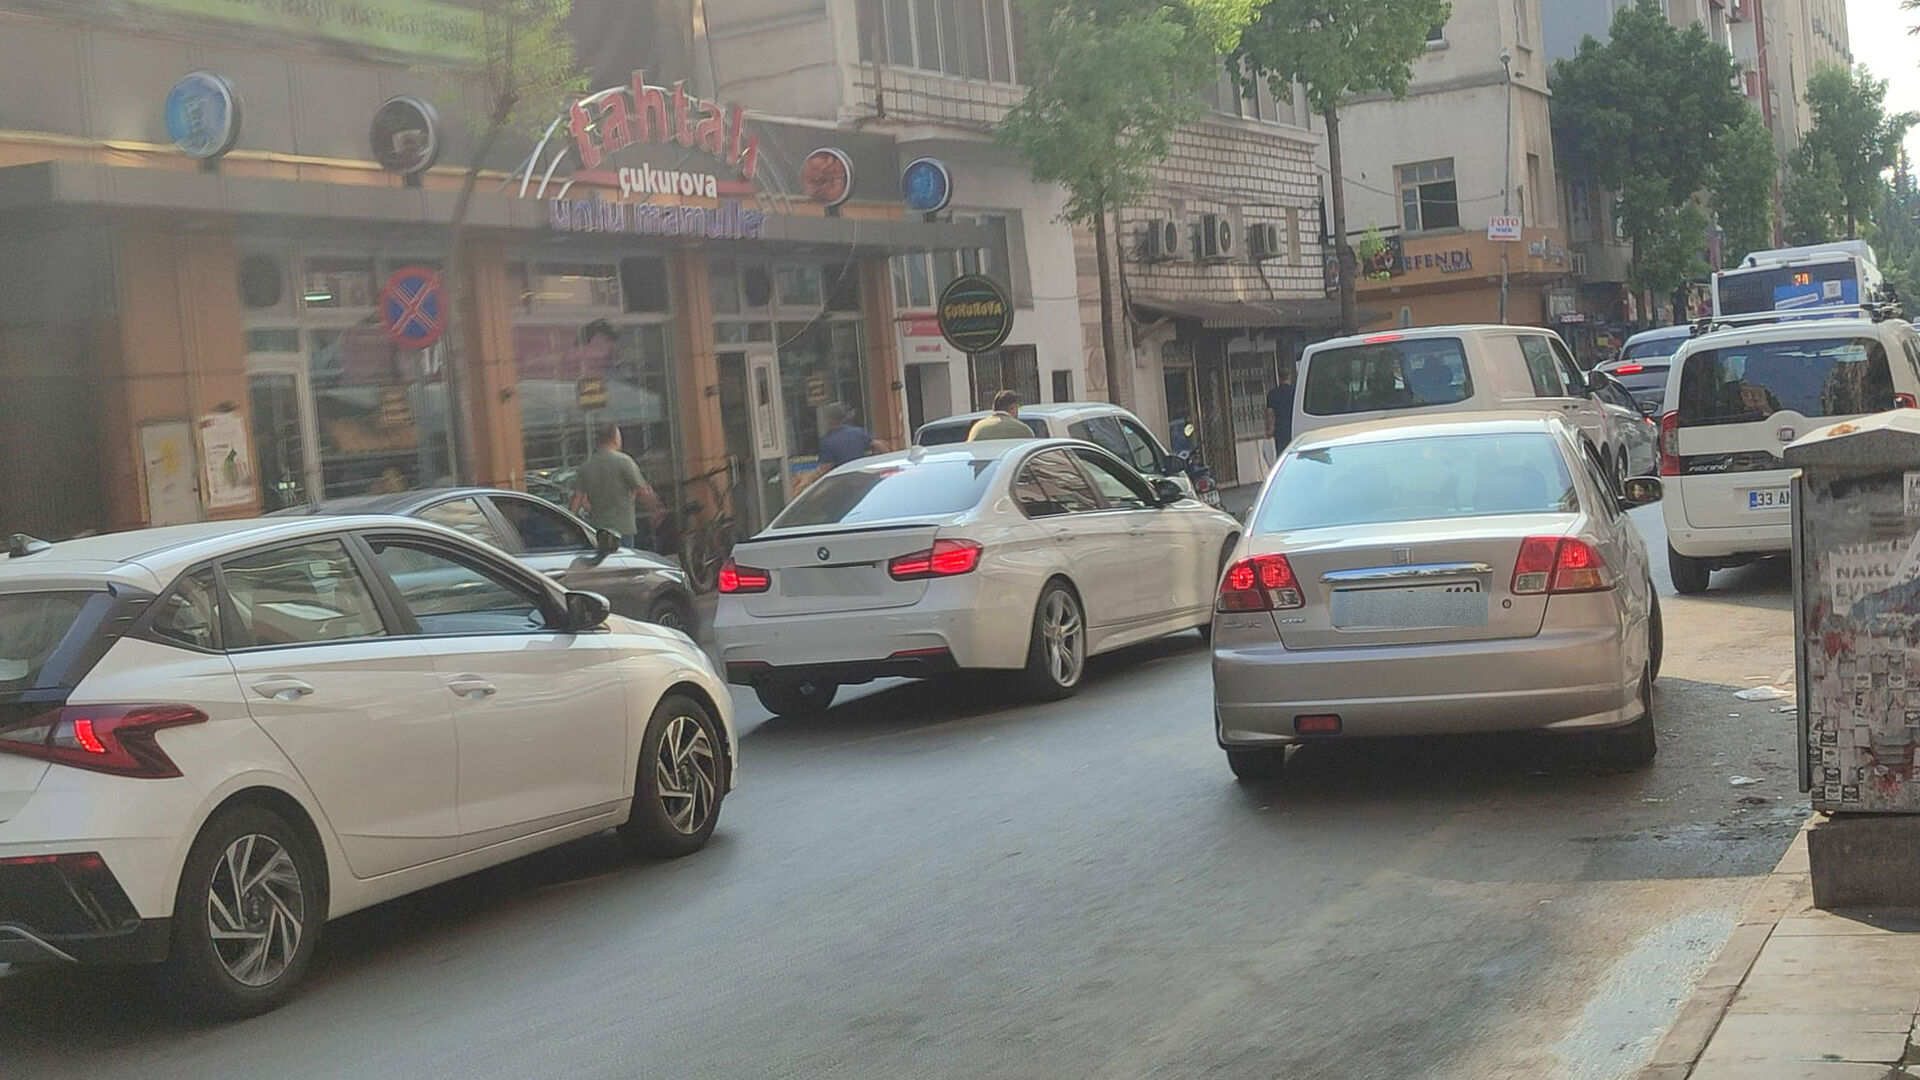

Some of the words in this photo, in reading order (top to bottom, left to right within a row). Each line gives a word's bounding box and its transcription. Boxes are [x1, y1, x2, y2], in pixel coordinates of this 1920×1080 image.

[618, 163, 718, 198] çukurova
[1491, 217, 1519, 227] FOTO
[1757, 492, 1773, 506] 33
